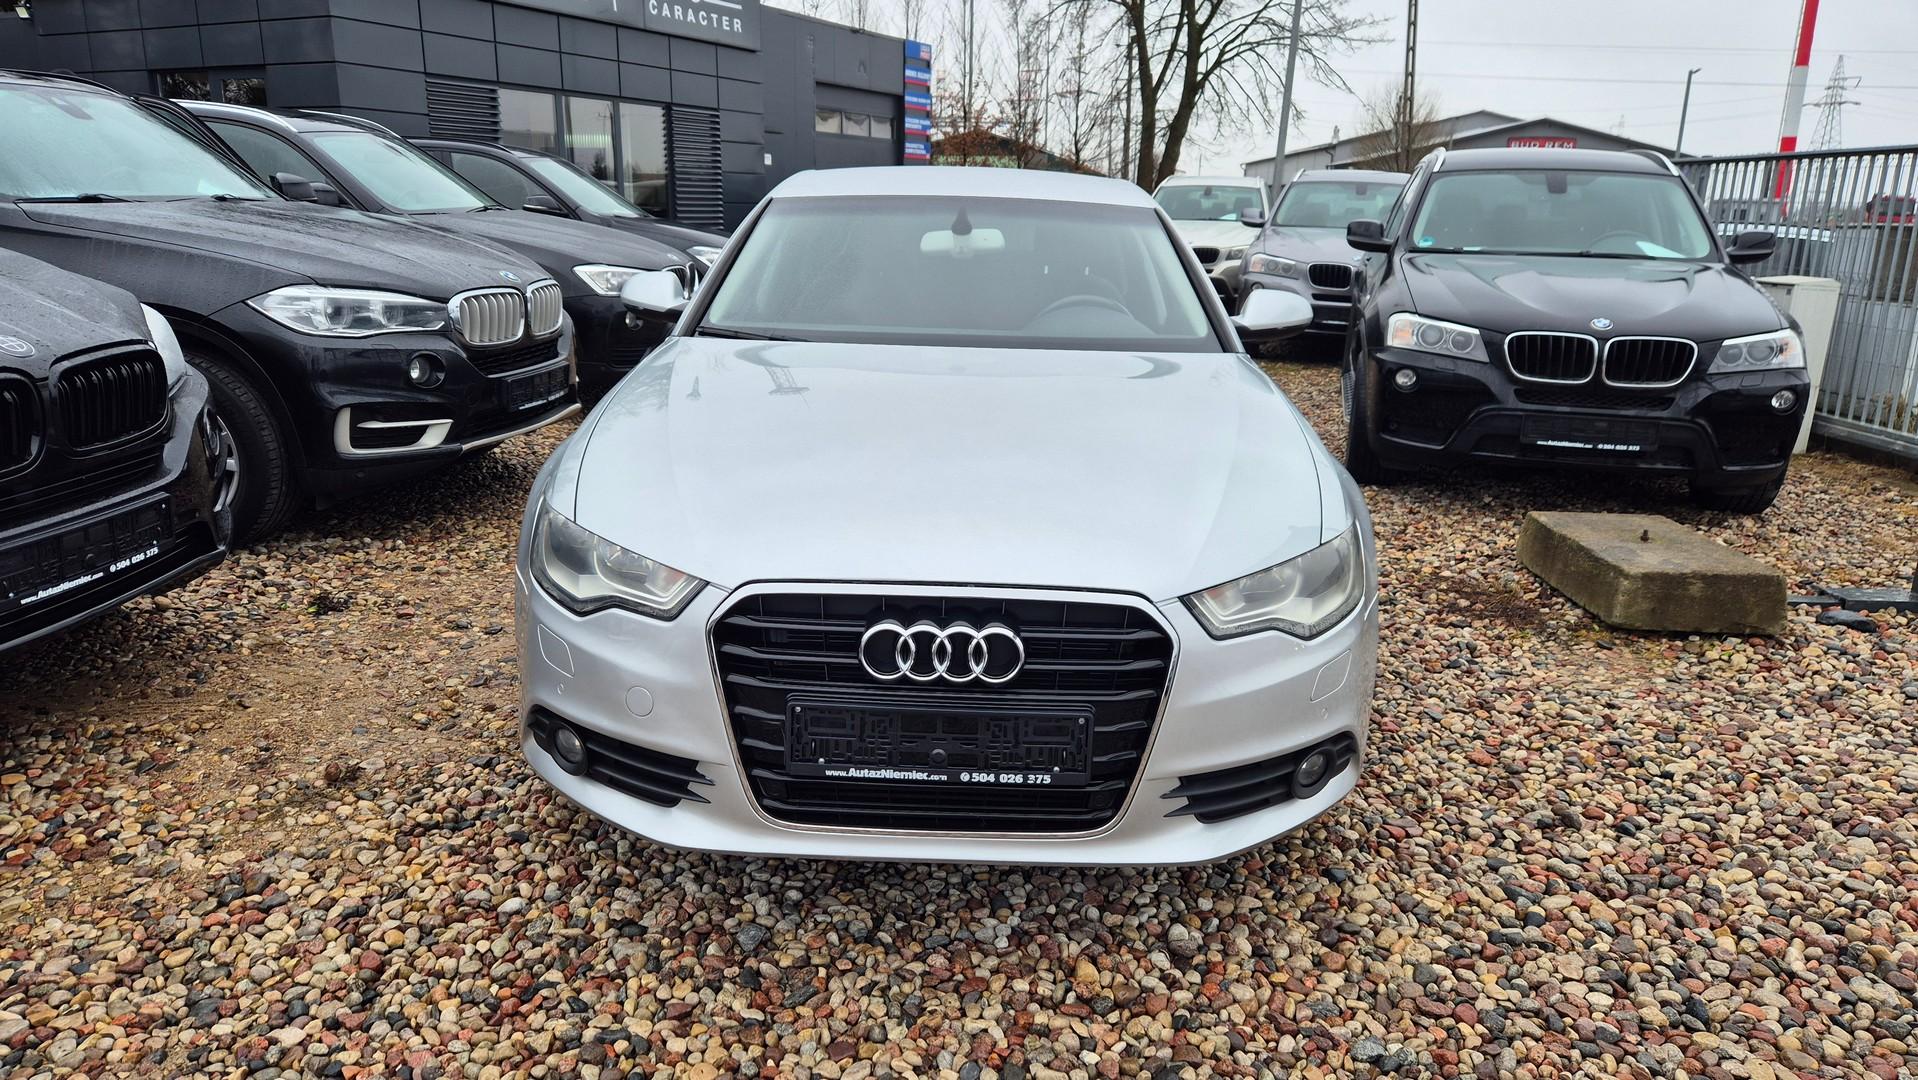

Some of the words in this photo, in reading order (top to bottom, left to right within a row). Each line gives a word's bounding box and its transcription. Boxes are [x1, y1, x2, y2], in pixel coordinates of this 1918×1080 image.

[648, 1, 742, 33] CARACTER
[825, 768, 947, 781] www.AutazNiemiec.com
[971, 772, 995, 782] 504
[999, 773, 1023, 784] 026
[1027, 774, 1051, 784] 375
